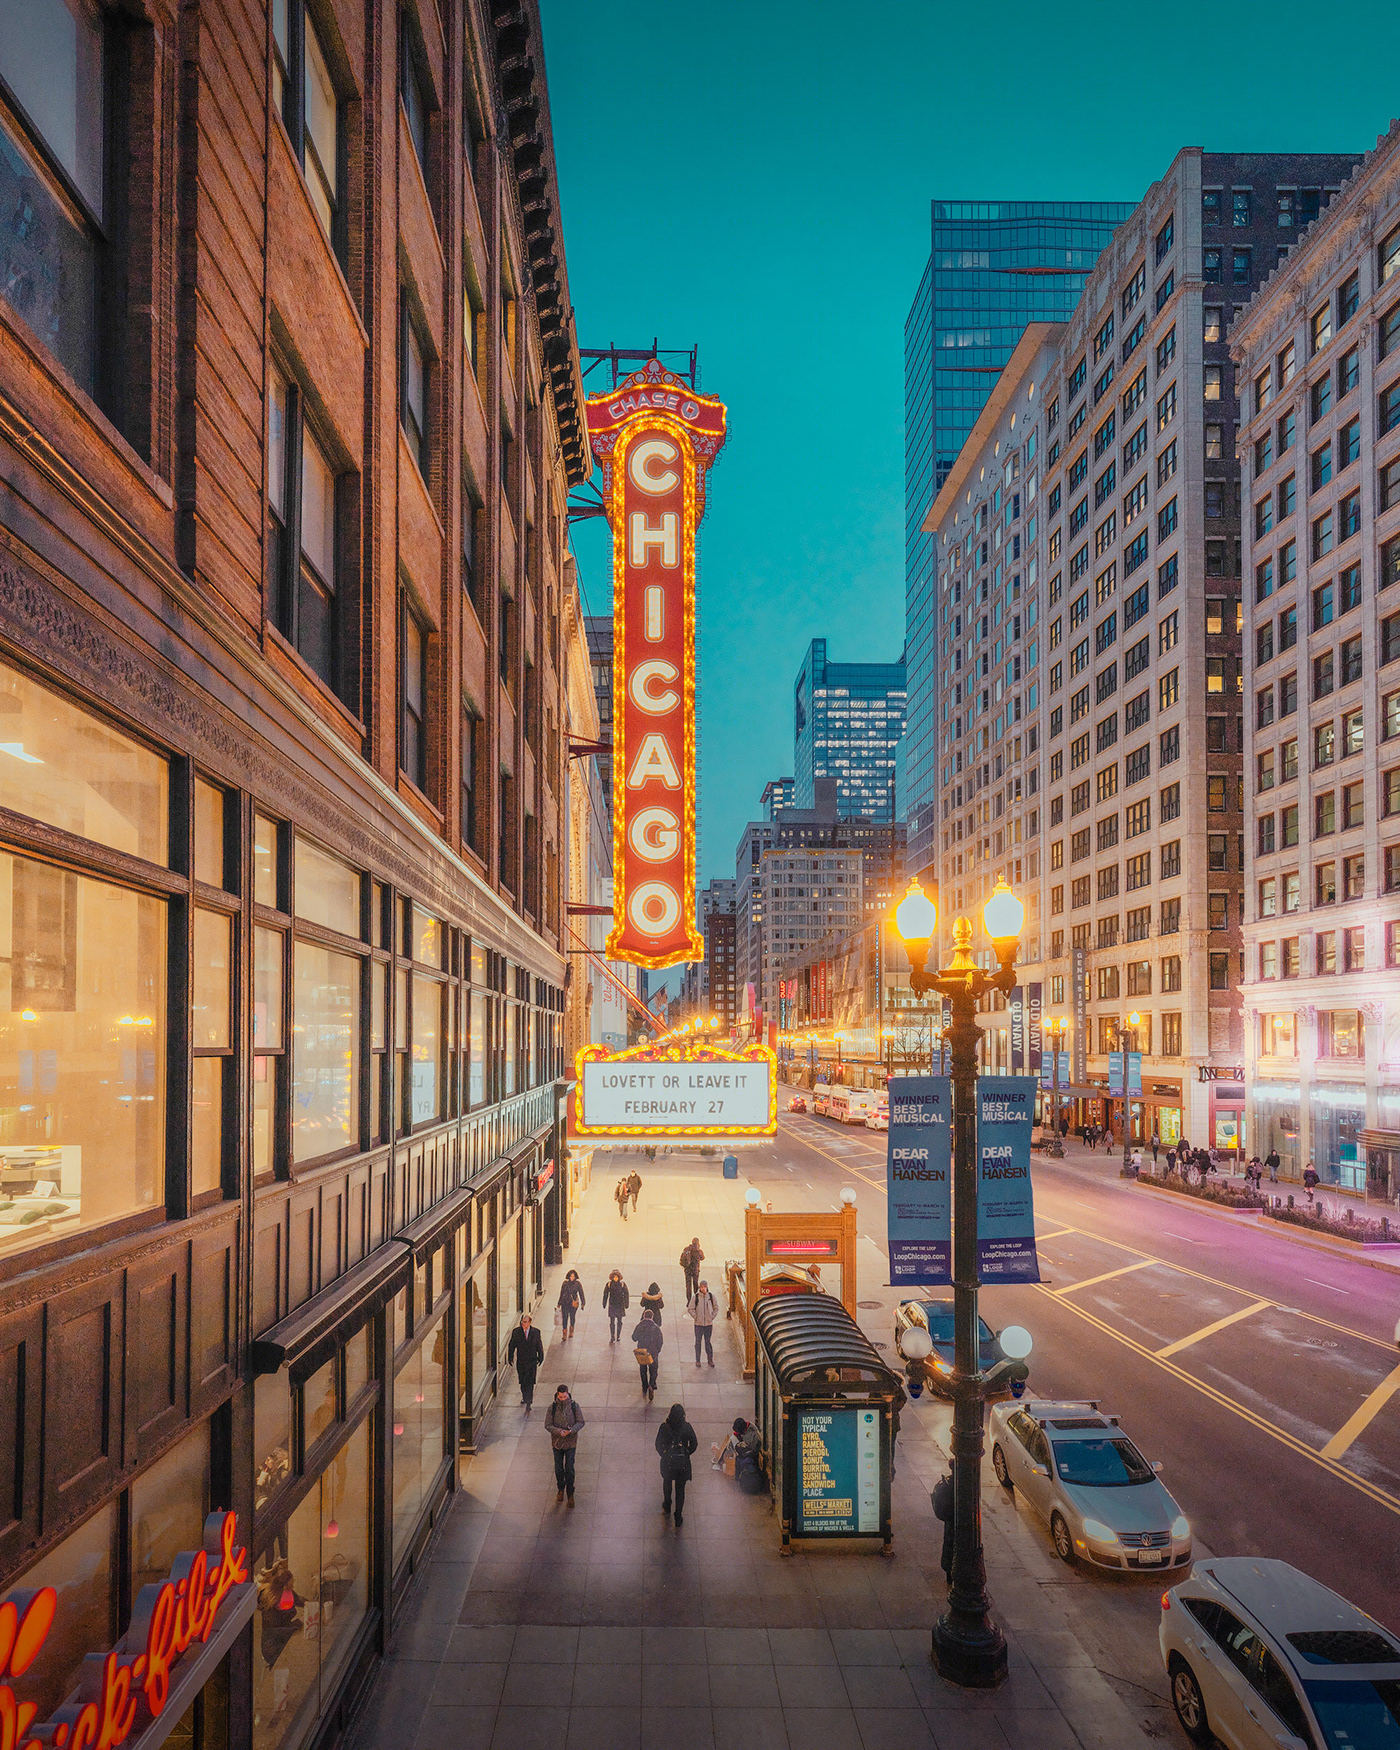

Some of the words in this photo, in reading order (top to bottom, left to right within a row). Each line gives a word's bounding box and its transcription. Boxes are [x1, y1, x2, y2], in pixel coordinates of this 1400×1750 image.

[609, 392, 679, 420] CHASE
[629, 439, 681, 938] CHICAGO
[1012, 1001, 1022, 1022] OLD
[1030, 998, 1040, 1020] OLD
[1012, 1024, 1022, 1052] NAVY
[1030, 1024, 1040, 1052] NAVY
[602, 1075, 656, 1089] LOVETT
[662, 1075, 680, 1088] OR
[688, 1075, 730, 1088] LEAVE
[735, 1075, 748, 1088] IT
[894, 1095, 940, 1104] WINNER
[982, 1094, 1026, 1102] WINNER
[625, 1100, 696, 1114] FEBRUARY
[708, 1100, 724, 1114] 27
[894, 1104, 924, 1114] BEST
[982, 1102, 1010, 1112] BEST
[893, 1114, 944, 1124] MUSICAL
[982, 1112, 1028, 1121] MUSICAL
[1162, 1107, 1171, 1143] cricket
[892, 1148, 928, 1160] DEAR
[982, 1146, 1012, 1158] DEAR
[892, 1159, 926, 1170] EVAN
[982, 1158, 1011, 1169] EVAN
[892, 1170, 944, 1181] HANSEN
[982, 1167, 1027, 1180] HANSEN
[894, 1253, 946, 1261] LoopChicago.com
[982, 1251, 1032, 1259] LoopChicago.com
[802, 1416, 814, 1424] NOT
[816, 1416, 832, 1424] YOUR
[802, 1424, 828, 1432] TYPICAL
[802, 1432, 820, 1441] GYRO,
[802, 1440, 826, 1448] RAMEN,
[802, 1448, 830, 1456] PIEROGI,
[802, 1456, 824, 1464] DONUT,
[802, 1464, 831, 1472] BURRITO,
[802, 1472, 821, 1480] SUSHI
[802, 1480, 836, 1488] SANDWICH
[803, 1488, 824, 1496] PLACE.
[806, 1501, 824, 1509] WELLS
[828, 1500, 850, 1508] MARKET
